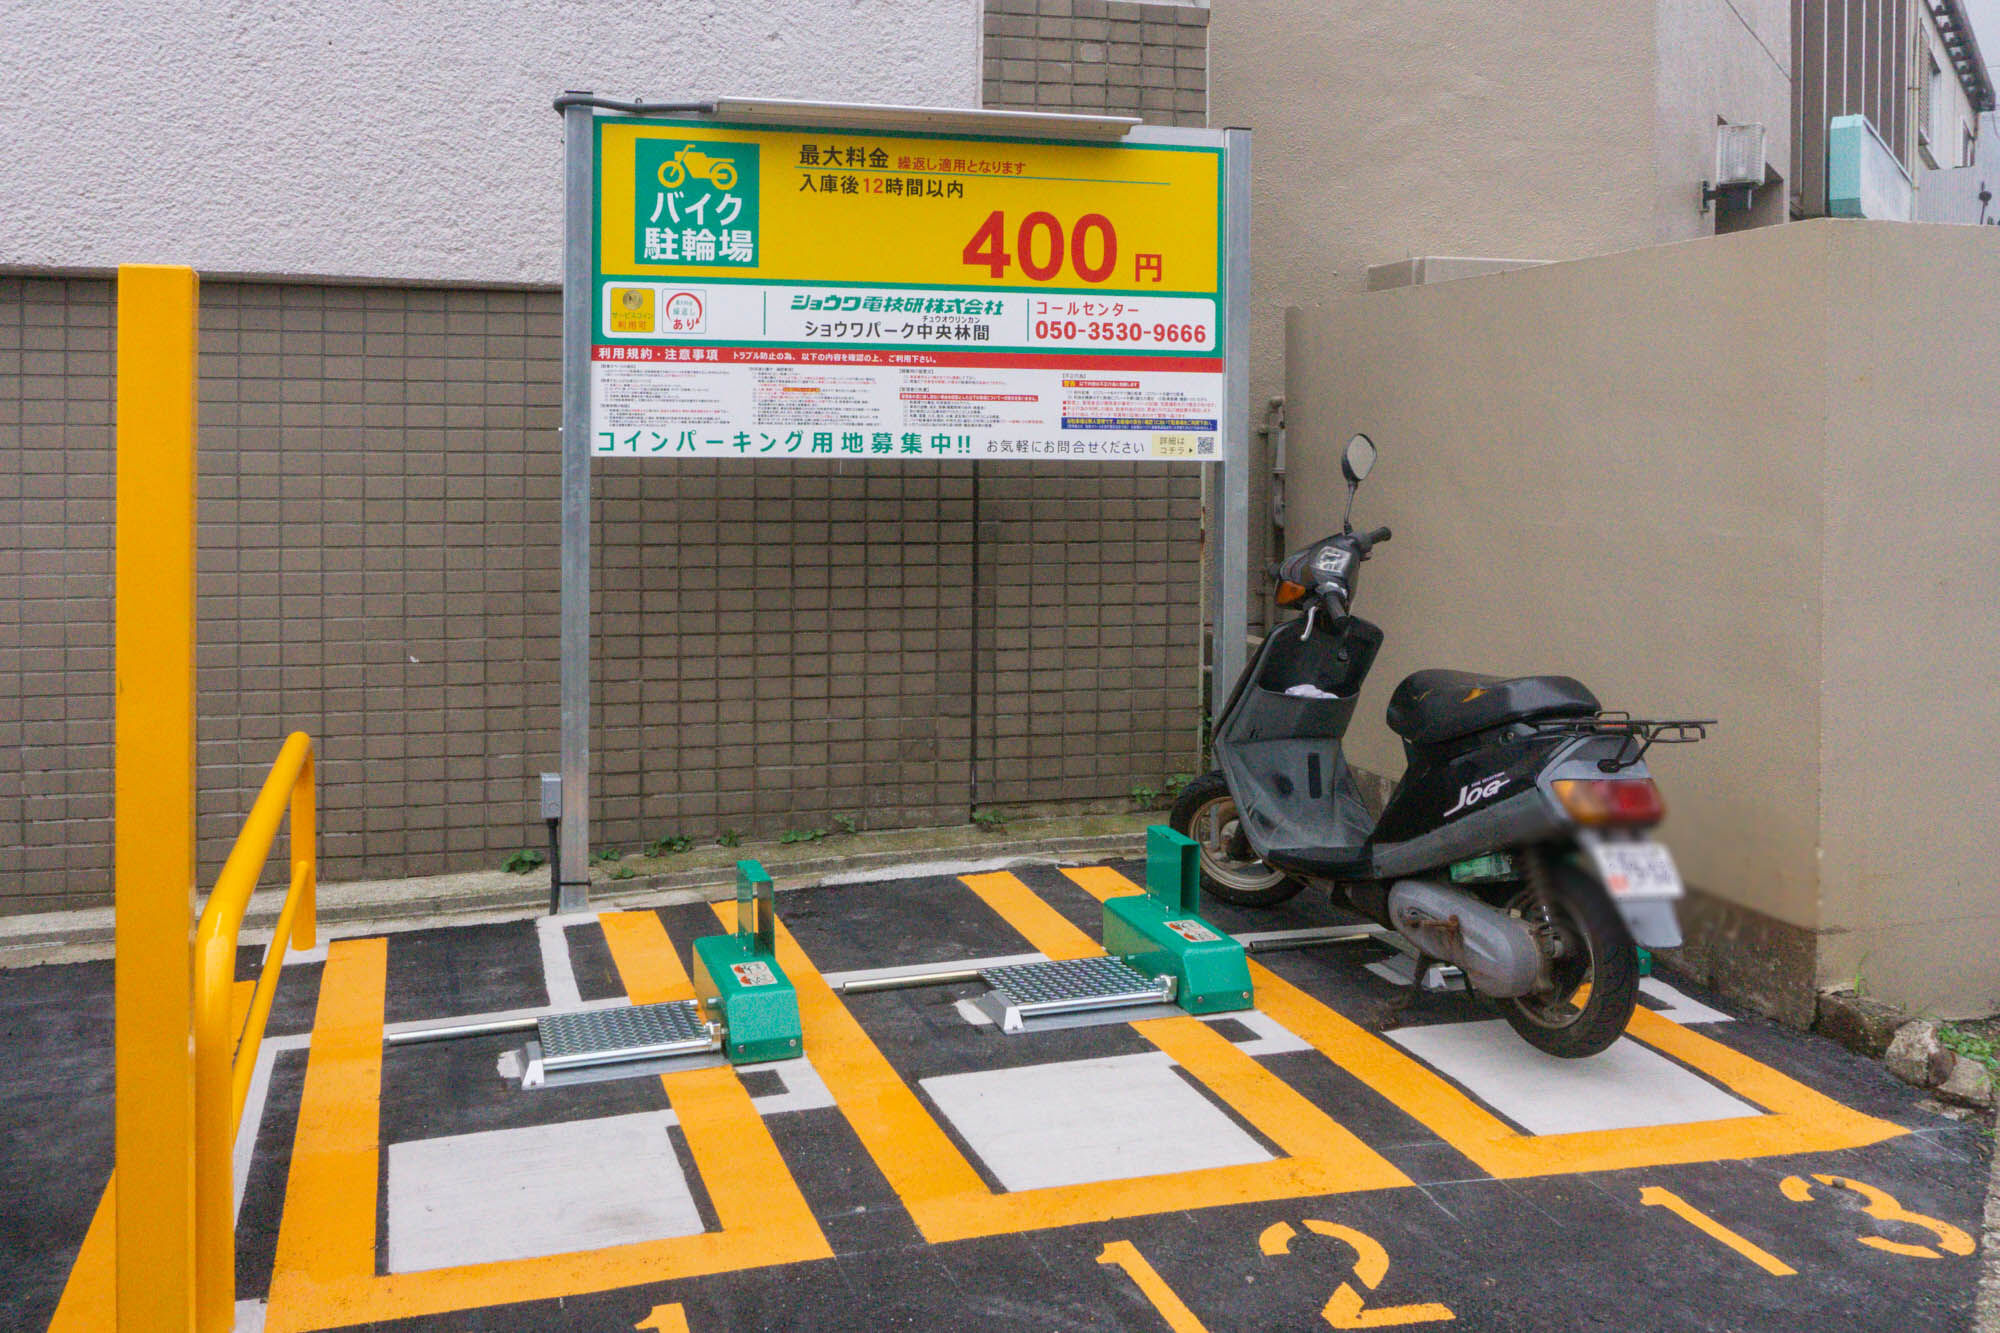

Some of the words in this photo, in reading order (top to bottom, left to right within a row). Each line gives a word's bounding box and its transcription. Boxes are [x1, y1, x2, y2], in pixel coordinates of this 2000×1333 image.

[799, 144, 889, 169] 最大料金
[897, 156, 1026, 175] 繰返し適用となります
[799, 172, 964, 199] 入庫後12時間以内
[649, 191, 743, 226] バイク
[644, 226, 754, 263] 駐輪場
[962, 210, 1118, 283] 400
[1134, 253, 1162, 283] 円
[791, 294, 1003, 315] ショウワ電技研株式会社
[1036, 301, 1139, 317] コールセンター
[673, 318, 695, 331] あり
[805, 321, 990, 342] ショウワパーク中央林間
[1035, 320, 1206, 343] 050-3530-9666
[598, 347, 719, 362] 利用規約・注意事項
[598, 429, 971, 455] コインパーキング用地募集中!!
[986, 438, 1145, 455] お気軽にお問合せください
[1443, 778, 1511, 817] JOG
